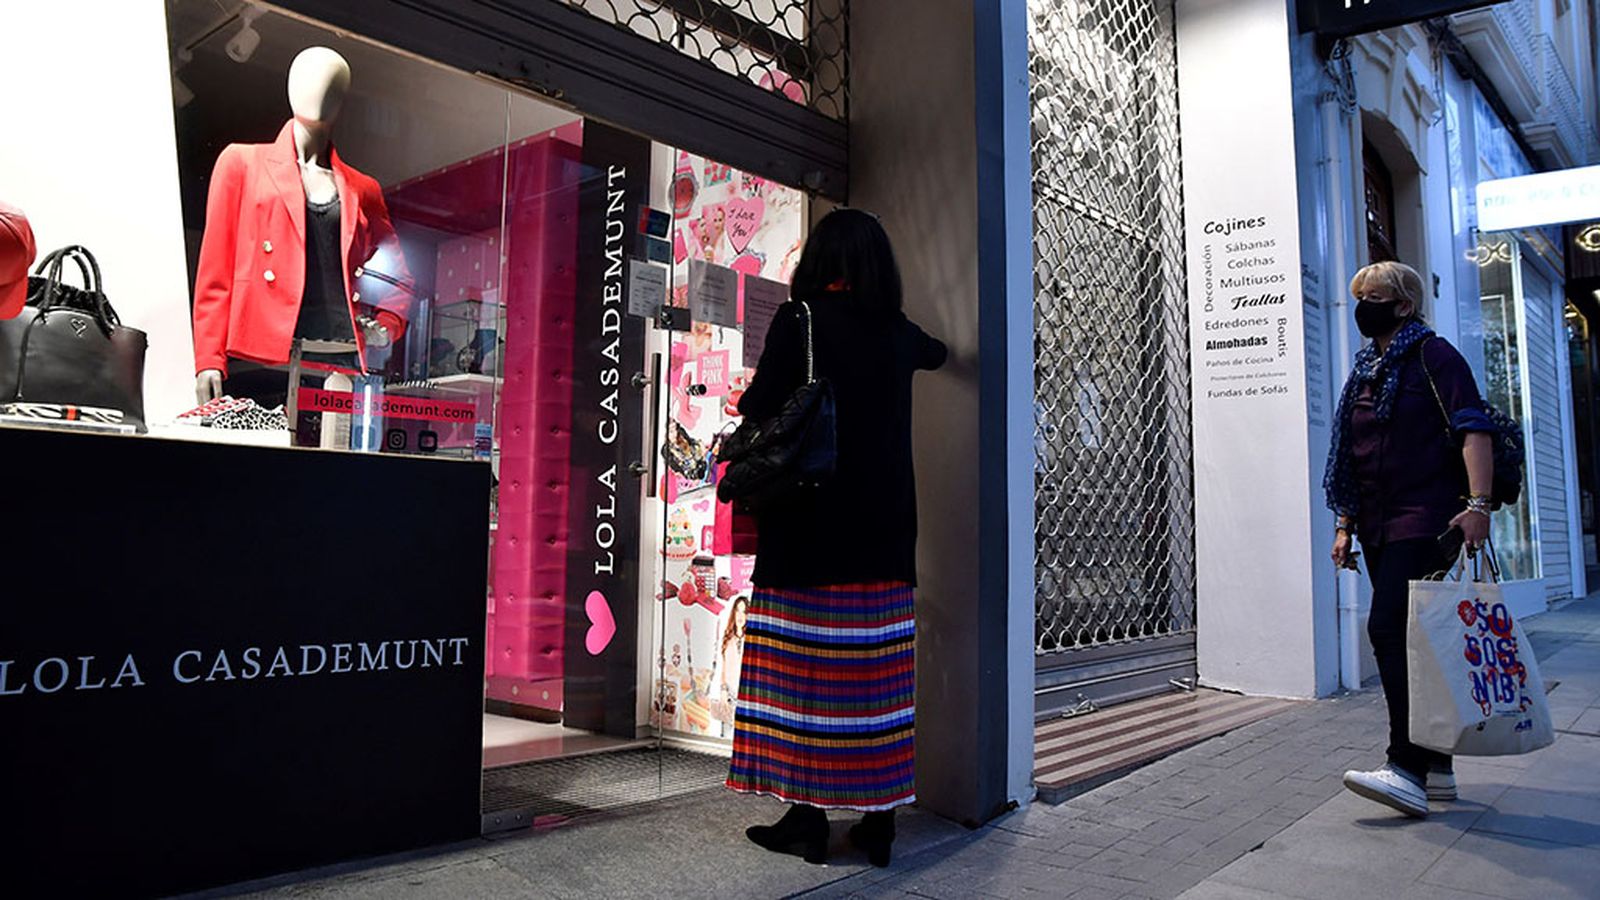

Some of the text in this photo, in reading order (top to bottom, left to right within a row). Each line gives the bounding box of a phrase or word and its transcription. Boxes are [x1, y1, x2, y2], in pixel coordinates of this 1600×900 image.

[1203, 216, 1266, 236] Cojines
[1225, 239, 1276, 254] Sábanas
[1227, 256, 1276, 270] Colchas
[1202, 244, 1214, 313] Decoración
[1219, 273, 1286, 289] Multiusos
[1204, 316, 1270, 331] Edredones
[1205, 336, 1269, 351] Almohadas
[1277, 317, 1288, 358] Boutis
[1232, 358, 1243, 366] de
[1245, 356, 1275, 365] Cocina
[594, 165, 626, 575] LOLA CASADEMUNT
[1207, 384, 1289, 399] Fundas de Sofás
[314, 393, 474, 420] lolacaademunt.com
[0, 637, 470, 696] LOLA CASADEMUNT
